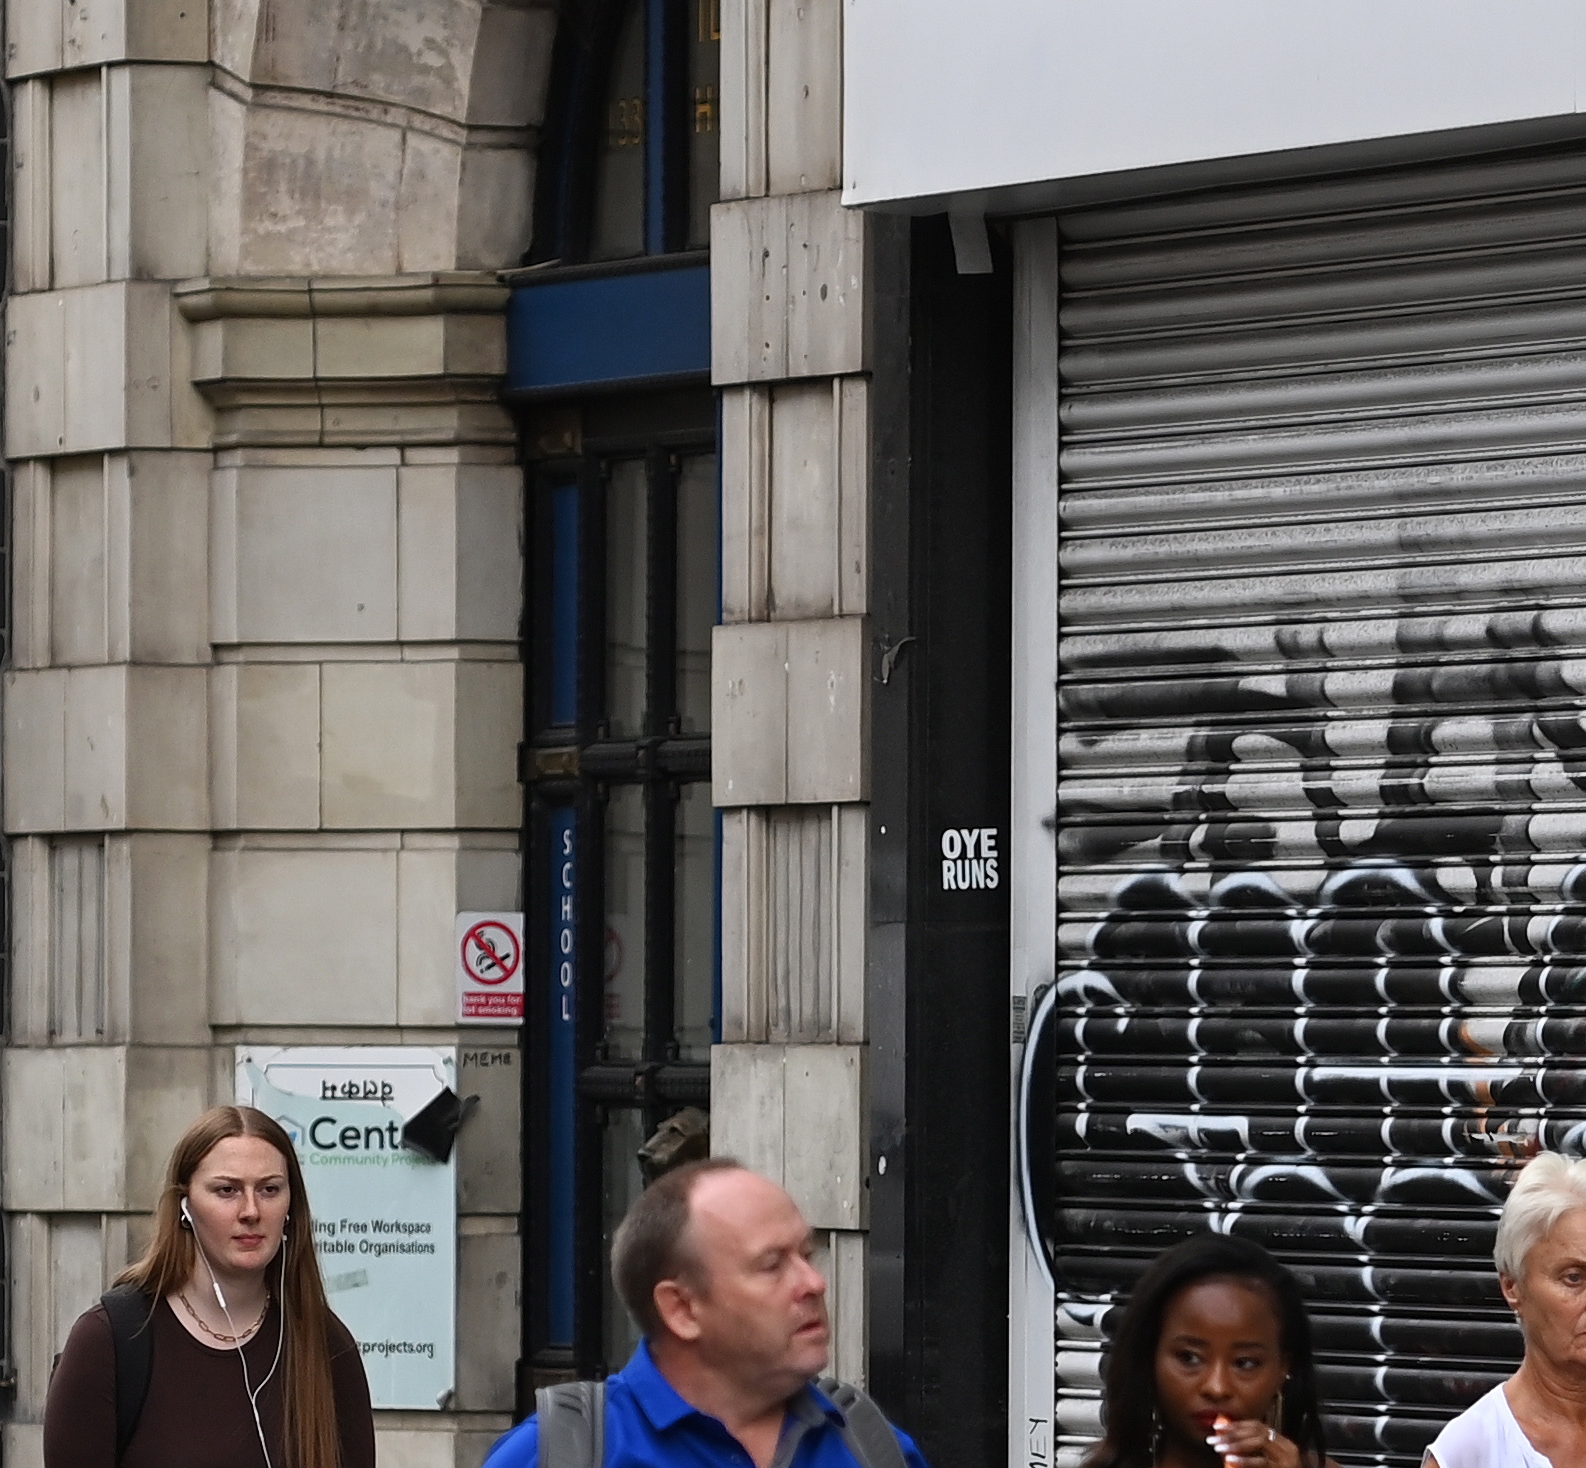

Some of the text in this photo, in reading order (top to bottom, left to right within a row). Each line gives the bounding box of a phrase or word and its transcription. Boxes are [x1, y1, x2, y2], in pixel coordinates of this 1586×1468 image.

[941, 828, 999, 860] OYE
[941, 858, 1000, 891] RUNS
[559, 828, 574, 1022] SCHOOL
[310, 1115, 404, 1151] Cent
[309, 1151, 388, 1167] Community
[340, 1218, 368, 1234] Free
[371, 1219, 432, 1237] Workspace
[359, 1239, 435, 1257] Organisations
